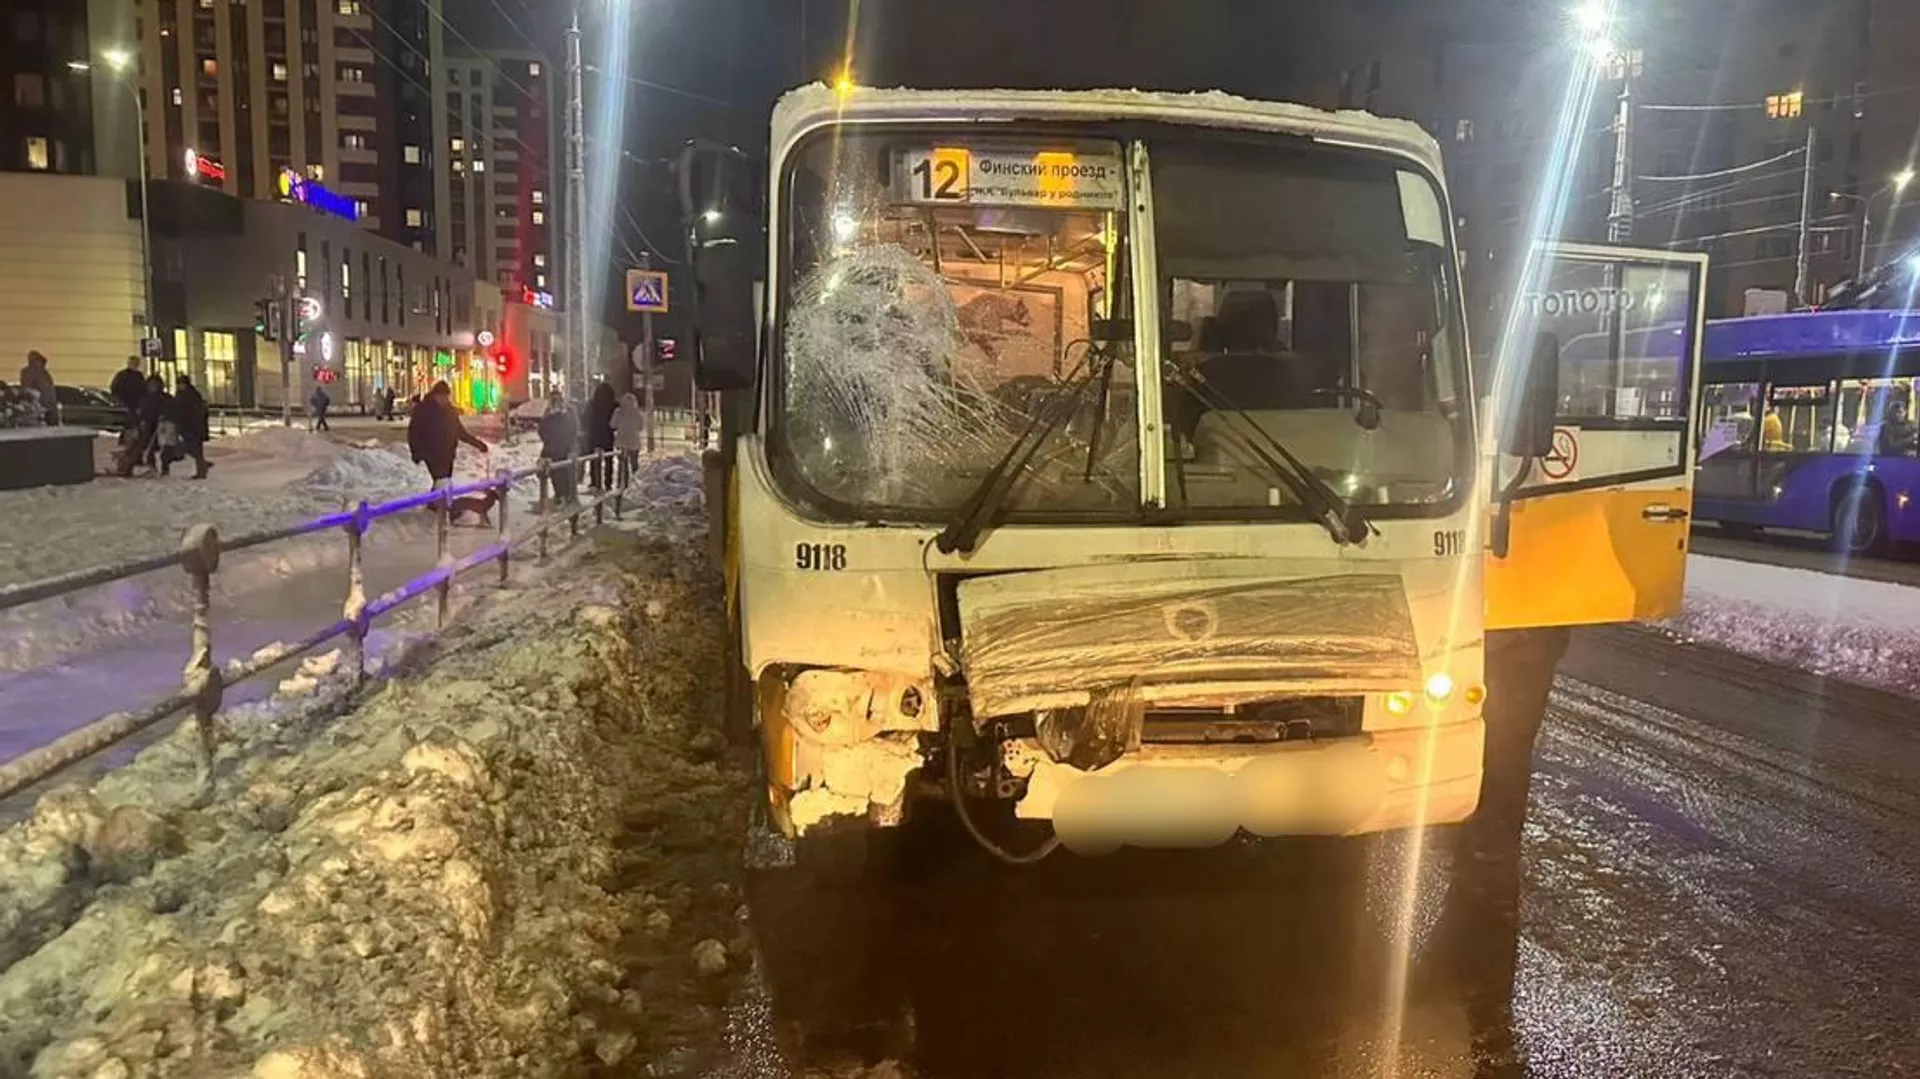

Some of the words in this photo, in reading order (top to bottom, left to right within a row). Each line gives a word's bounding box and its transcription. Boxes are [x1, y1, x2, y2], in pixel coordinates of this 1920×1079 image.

[913, 158, 961, 199] 12
[979, 159, 1045, 176] Финский
[1051, 163, 1107, 180] проезд
[796, 542, 847, 571] 9118
[1434, 531, 1466, 557] 9118
